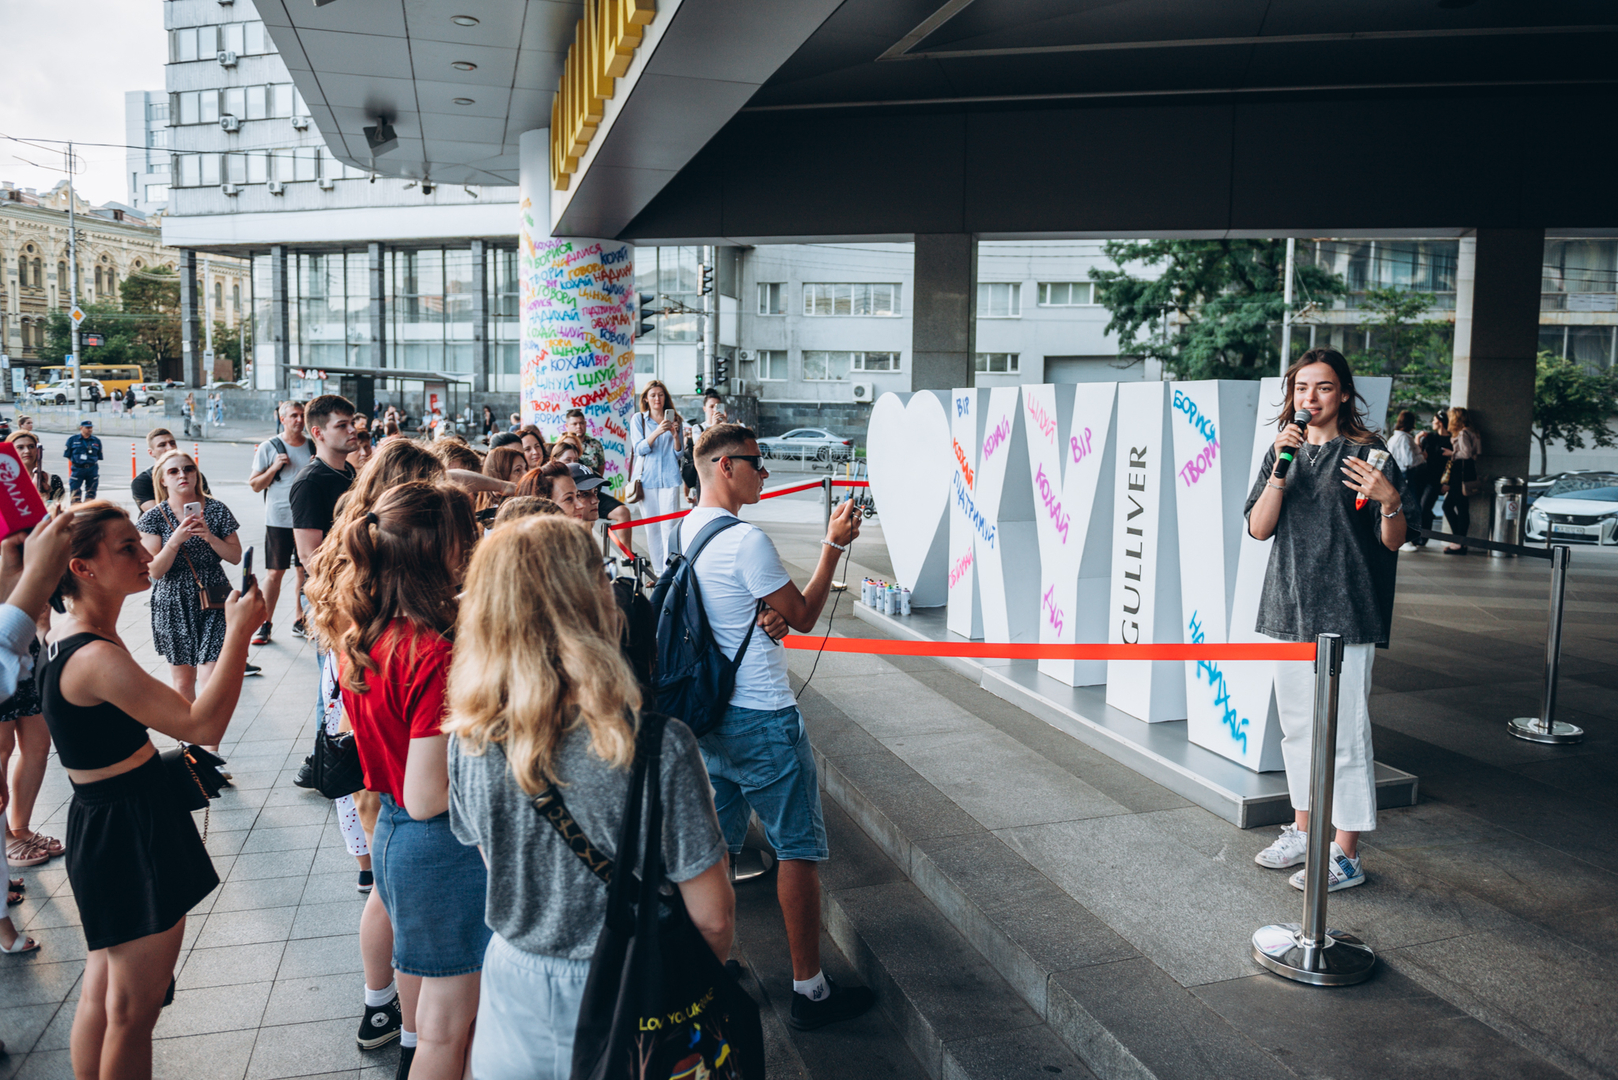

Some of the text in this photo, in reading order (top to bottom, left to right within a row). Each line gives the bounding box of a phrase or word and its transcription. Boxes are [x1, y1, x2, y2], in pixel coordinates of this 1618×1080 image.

[534, 241, 573, 269] БОРИСЯ
[599, 245, 628, 265] КОХАЙ
[529, 267, 564, 287] ТВОРИ
[560, 274, 594, 290] КОХАЙ
[567, 262, 606, 281] ГОВОРИ
[537, 284, 577, 309] ГОВОРИ
[550, 352, 597, 371] КОХАЙ
[595, 354, 610, 367] ВІР
[530, 399, 561, 412] ТВОРИ
[571, 383, 611, 408] КОХАЙ
[534, 412, 567, 424] БОРИС
[956, 396, 970, 418] ВІР
[1173, 389, 1216, 445] БОРИСЯ
[591, 426, 604, 437] ВІР
[1070, 427, 1092, 463] ВІР
[1178, 437, 1220, 488] ТВОРИ
[3, 481, 32, 517] KYIV
[1035, 462, 1071, 545] КОХАЙ
[1121, 446, 1147, 644] GULLIVER
